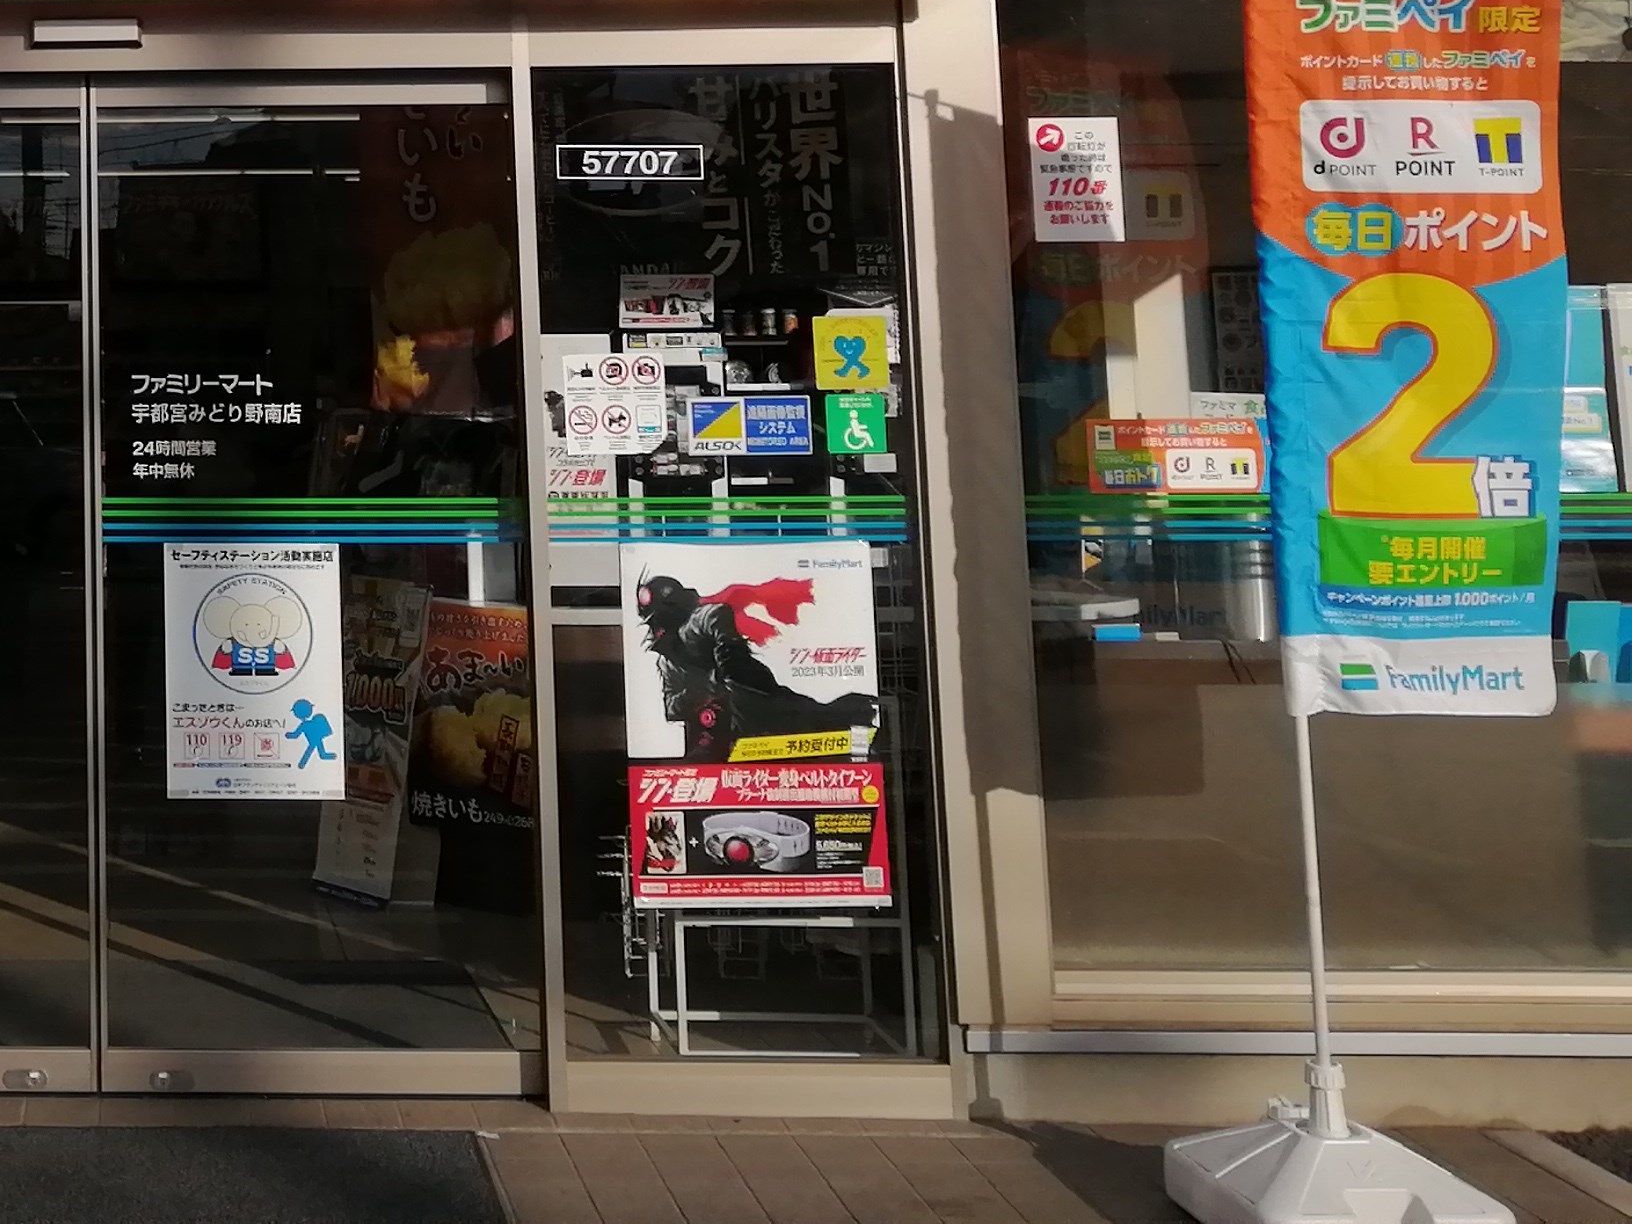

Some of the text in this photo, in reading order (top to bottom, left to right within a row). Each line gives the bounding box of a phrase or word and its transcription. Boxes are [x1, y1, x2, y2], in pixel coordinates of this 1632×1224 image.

[1478, 6, 1541, 33] 限定
[582, 150, 680, 175] 57707
[1329, 164, 1377, 176] POINT
[1395, 161, 1456, 176] POINT
[1049, 177, 1108, 196] 110番
[131, 374, 274, 396] ファミリーマート
[131, 402, 302, 424] 宇都宮みどり野南店
[759, 421, 796, 435] システム
[132, 440, 217, 456] 24時間営業
[695, 441, 742, 451] ALSOK
[132, 463, 195, 479] 年中無休
[813, 559, 863, 570] FamilyMart
[1369, 562, 1502, 585] 要エントリー
[238, 648, 269, 664] SS
[1386, 665, 1525, 695] FamilyMart
[187, 734, 208, 746] 110
[222, 734, 243, 746] 119
[786, 737, 848, 754] 予約受付中
[412, 790, 483, 823] 焼きいも
